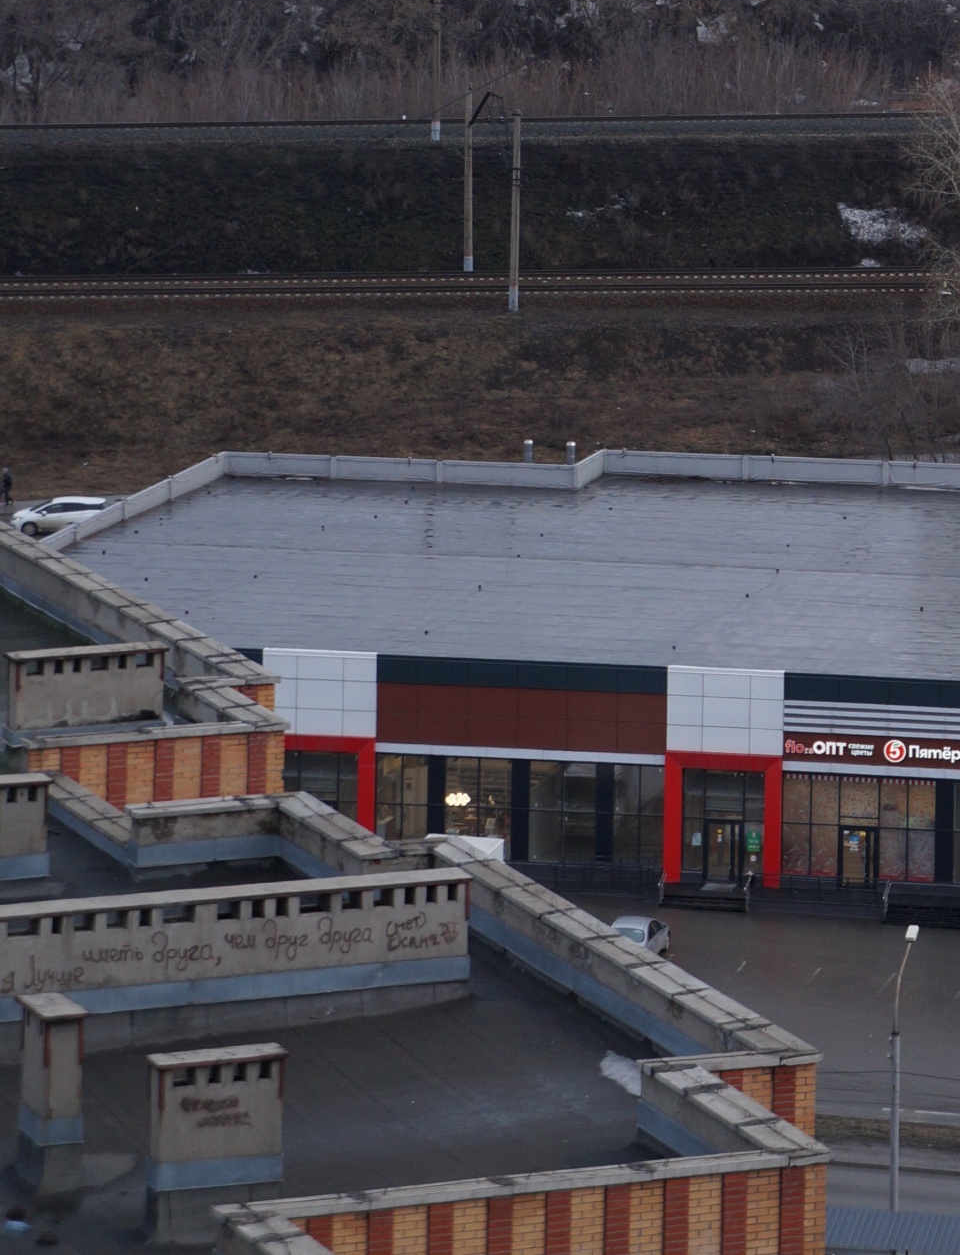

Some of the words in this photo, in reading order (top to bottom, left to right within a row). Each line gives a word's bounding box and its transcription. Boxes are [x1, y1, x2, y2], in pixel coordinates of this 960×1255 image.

[848, 743, 874, 751] свежие
[224, 932, 256, 949] чем
[263, 919, 308, 961] друг
[317, 917, 373, 953] друга
